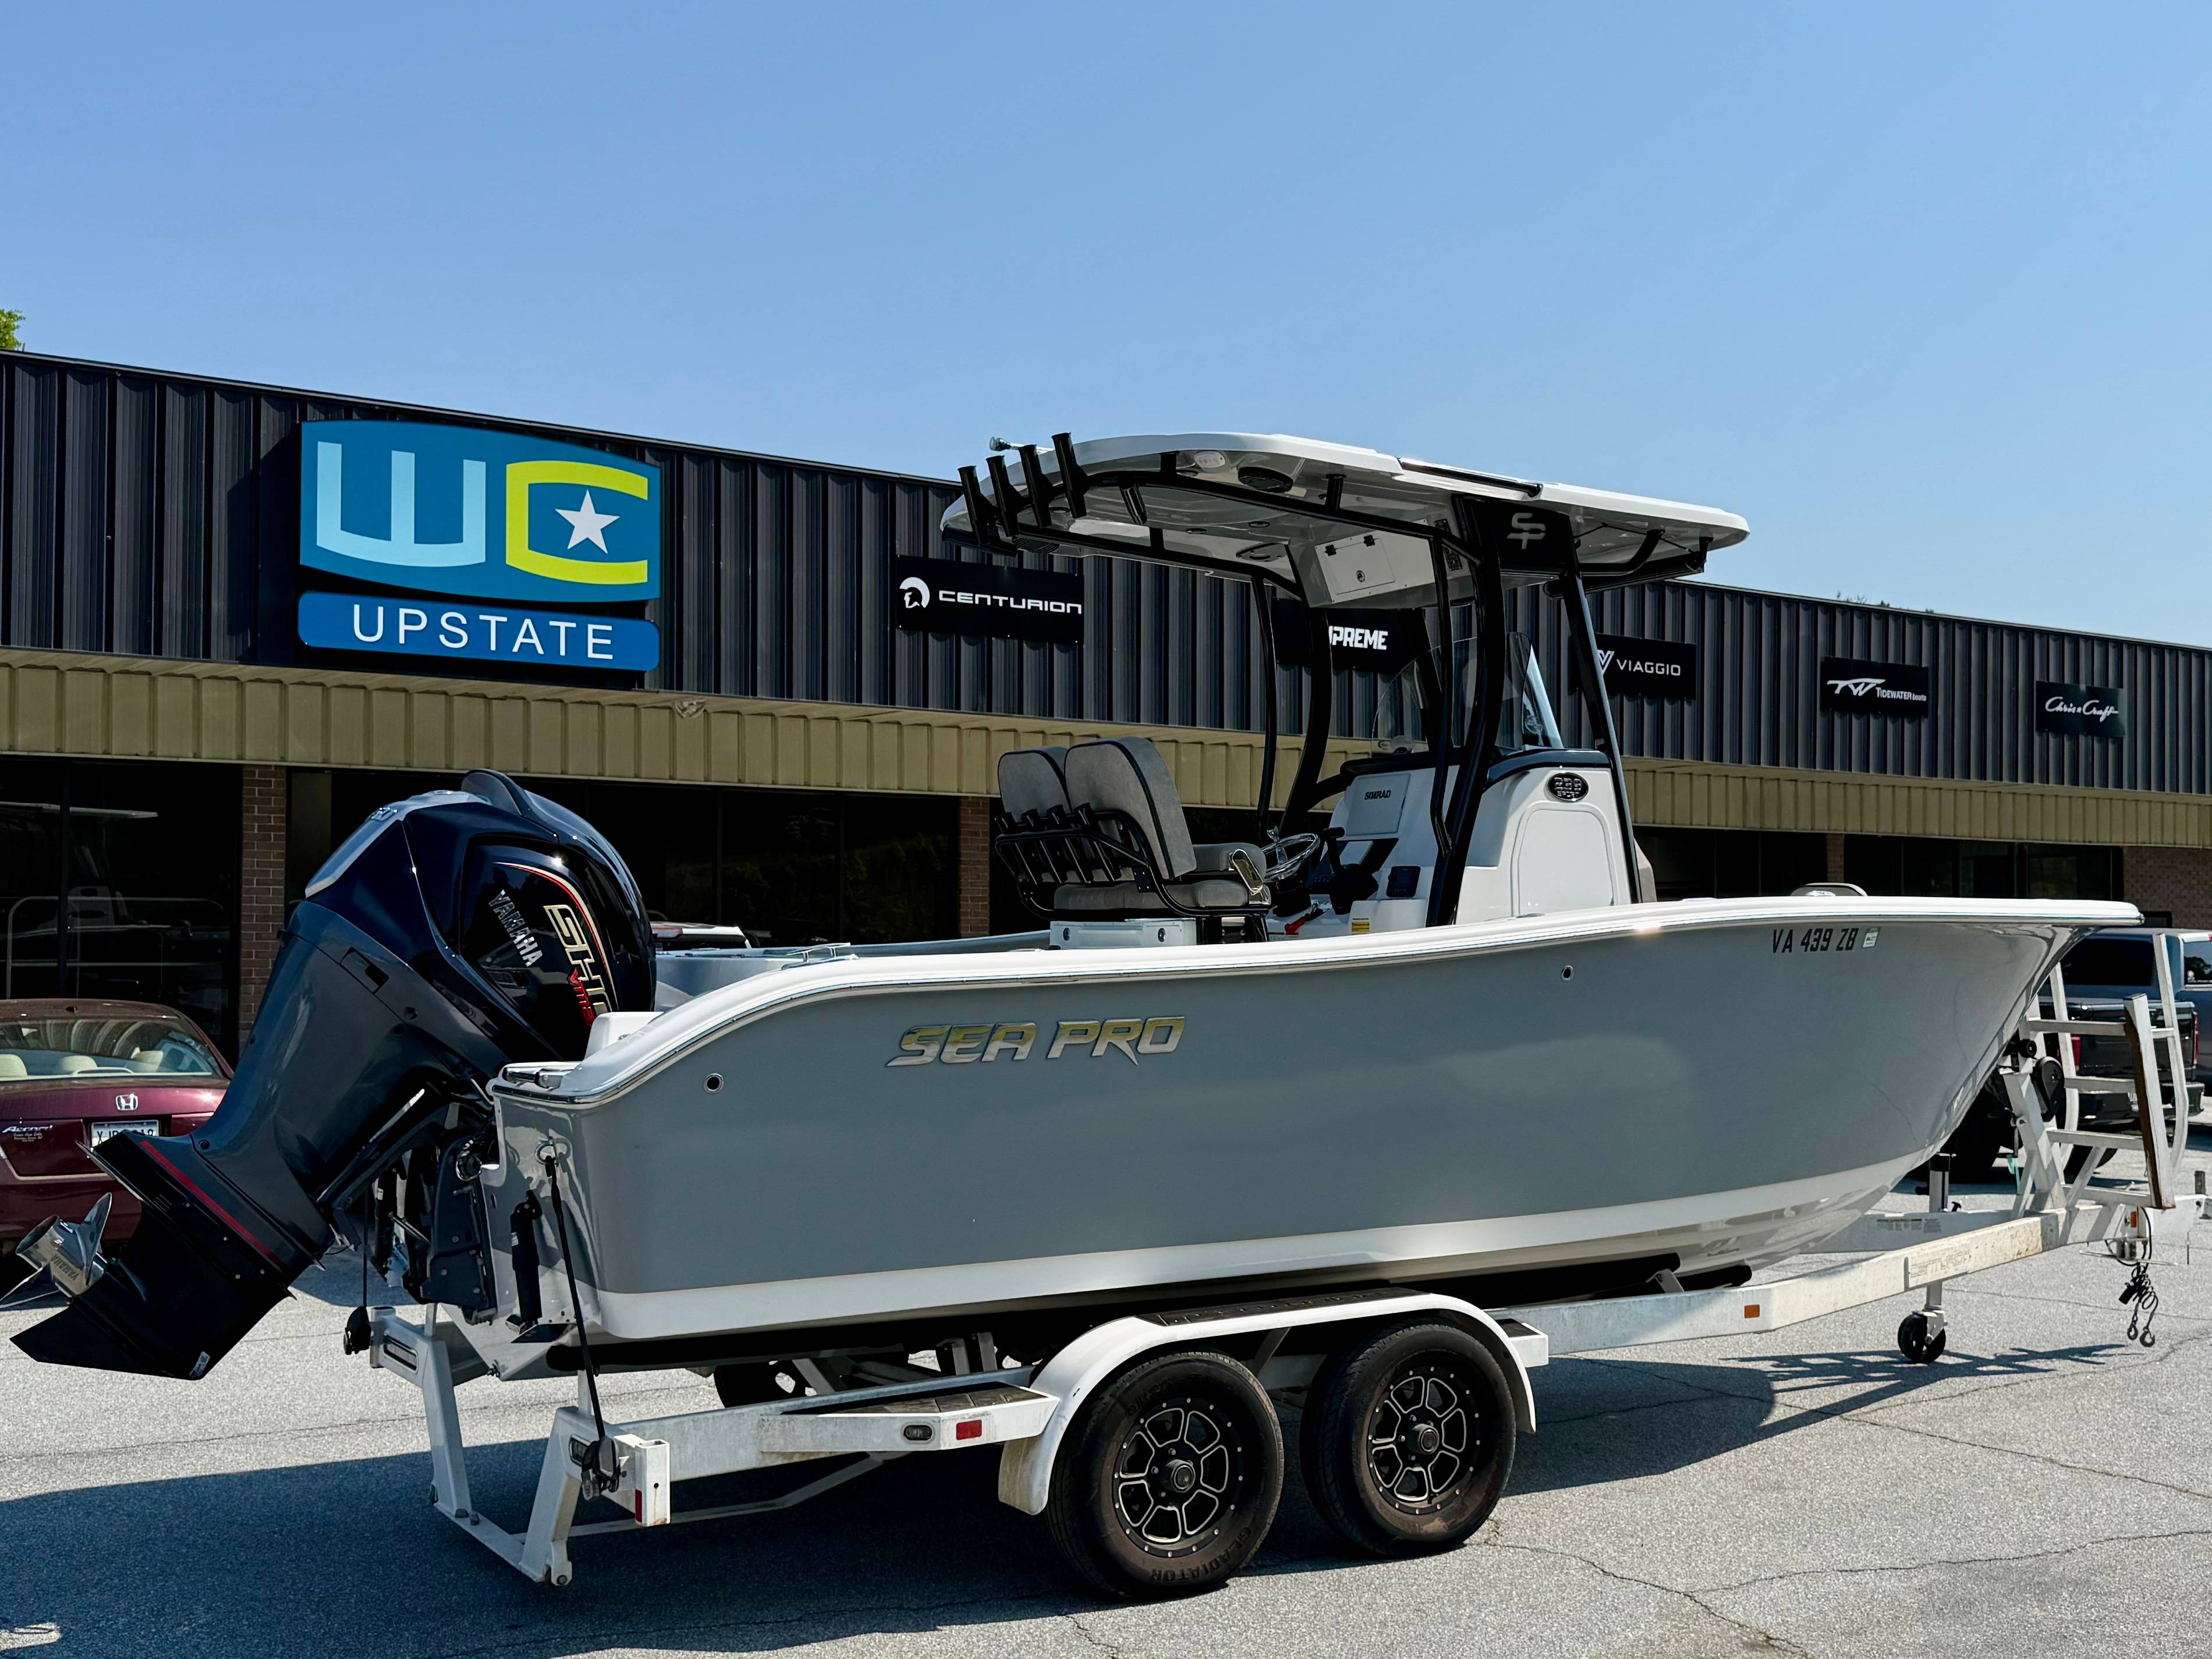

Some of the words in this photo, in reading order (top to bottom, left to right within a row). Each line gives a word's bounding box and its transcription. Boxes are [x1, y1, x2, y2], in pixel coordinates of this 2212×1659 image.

[938, 590, 1082, 615] CENTURION
[353, 604, 614, 660] UPSTATE
[1616, 658, 1681, 676] VIAGGIO
[1875, 687, 1912, 700] TIDEWATER
[1364, 789, 1391, 800] SIMRAD
[488, 889, 543, 967] YAMAHA
[1772, 929, 1793, 953] VA
[1800, 928, 1834, 952] 439
[885, 1022, 1038, 1068] SEA
[1046, 1016, 1186, 1066] PRO
[1150, 1527, 1251, 1581] GLADIATOR
